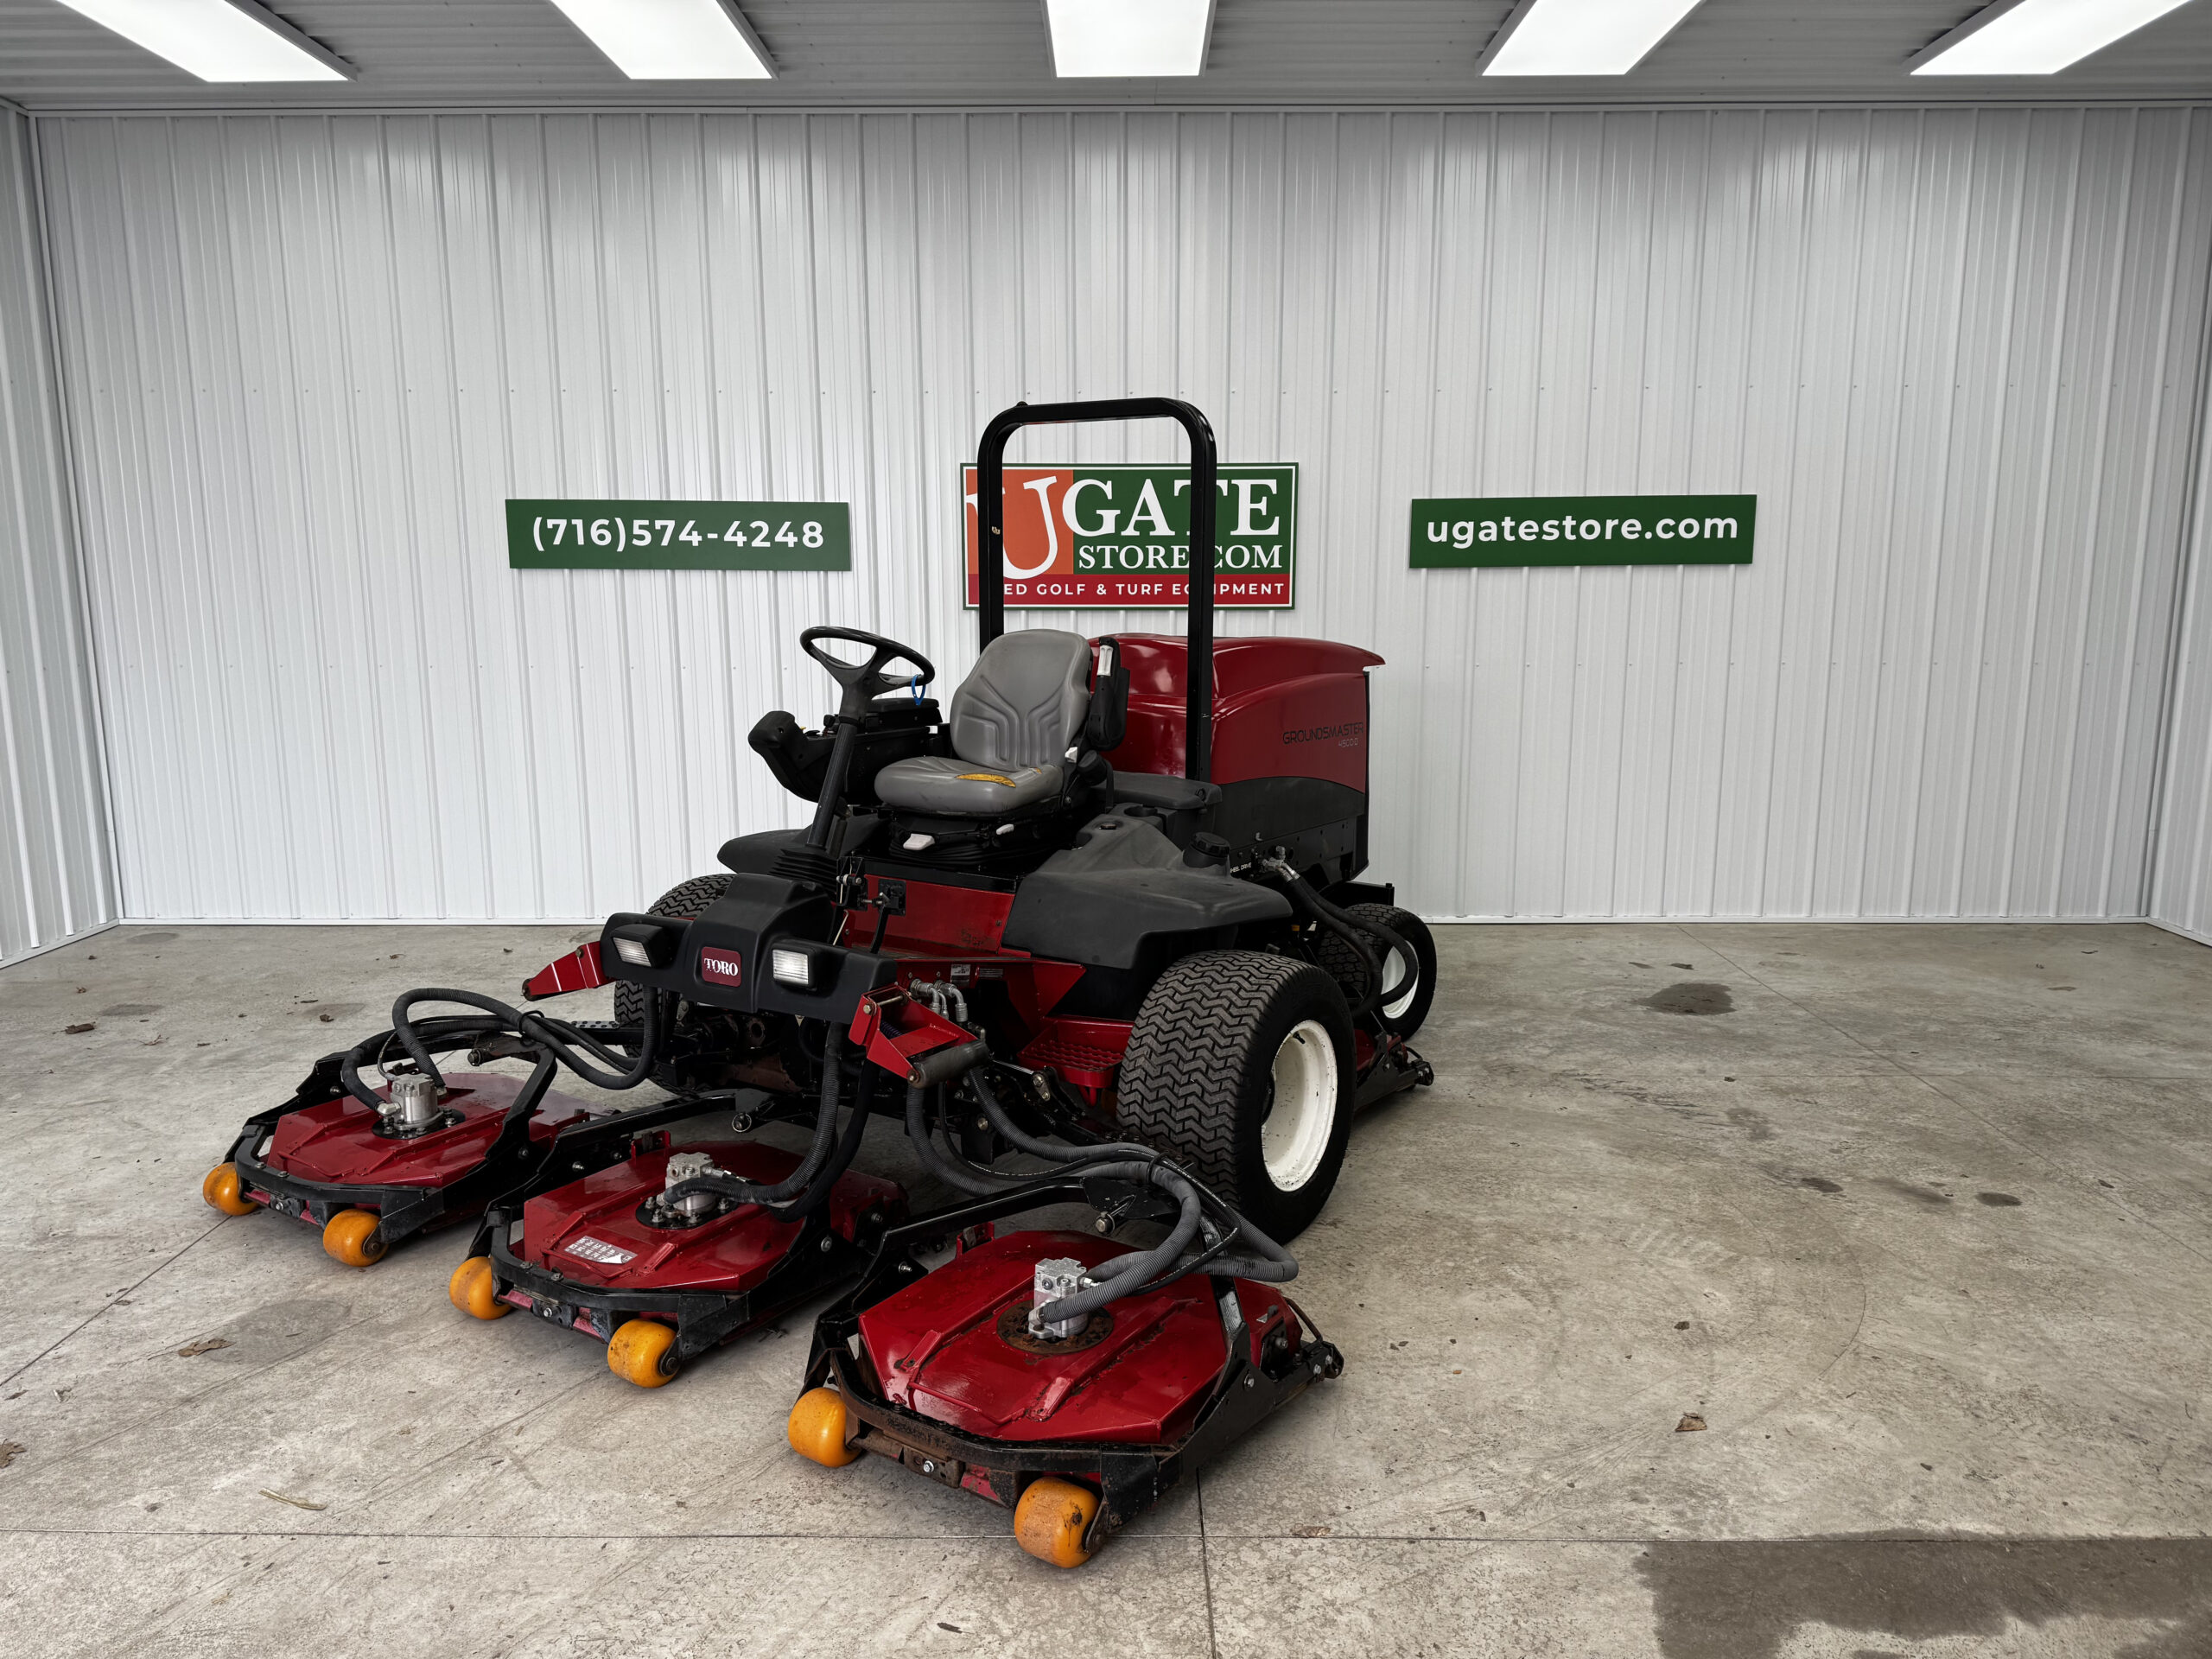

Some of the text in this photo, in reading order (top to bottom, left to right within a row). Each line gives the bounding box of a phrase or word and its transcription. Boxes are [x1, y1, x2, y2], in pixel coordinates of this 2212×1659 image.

[532, 517, 824, 552] (716)574-4248
[1427, 515, 1738, 550] ugatestore.com
[1078, 544, 1283, 569] STOREOM
[1003, 583, 1285, 595] ED GOLF & TURF EIPMENT
[1282, 721, 1363, 745] GROUNDSMASTER
[704, 957, 739, 976] TORO
